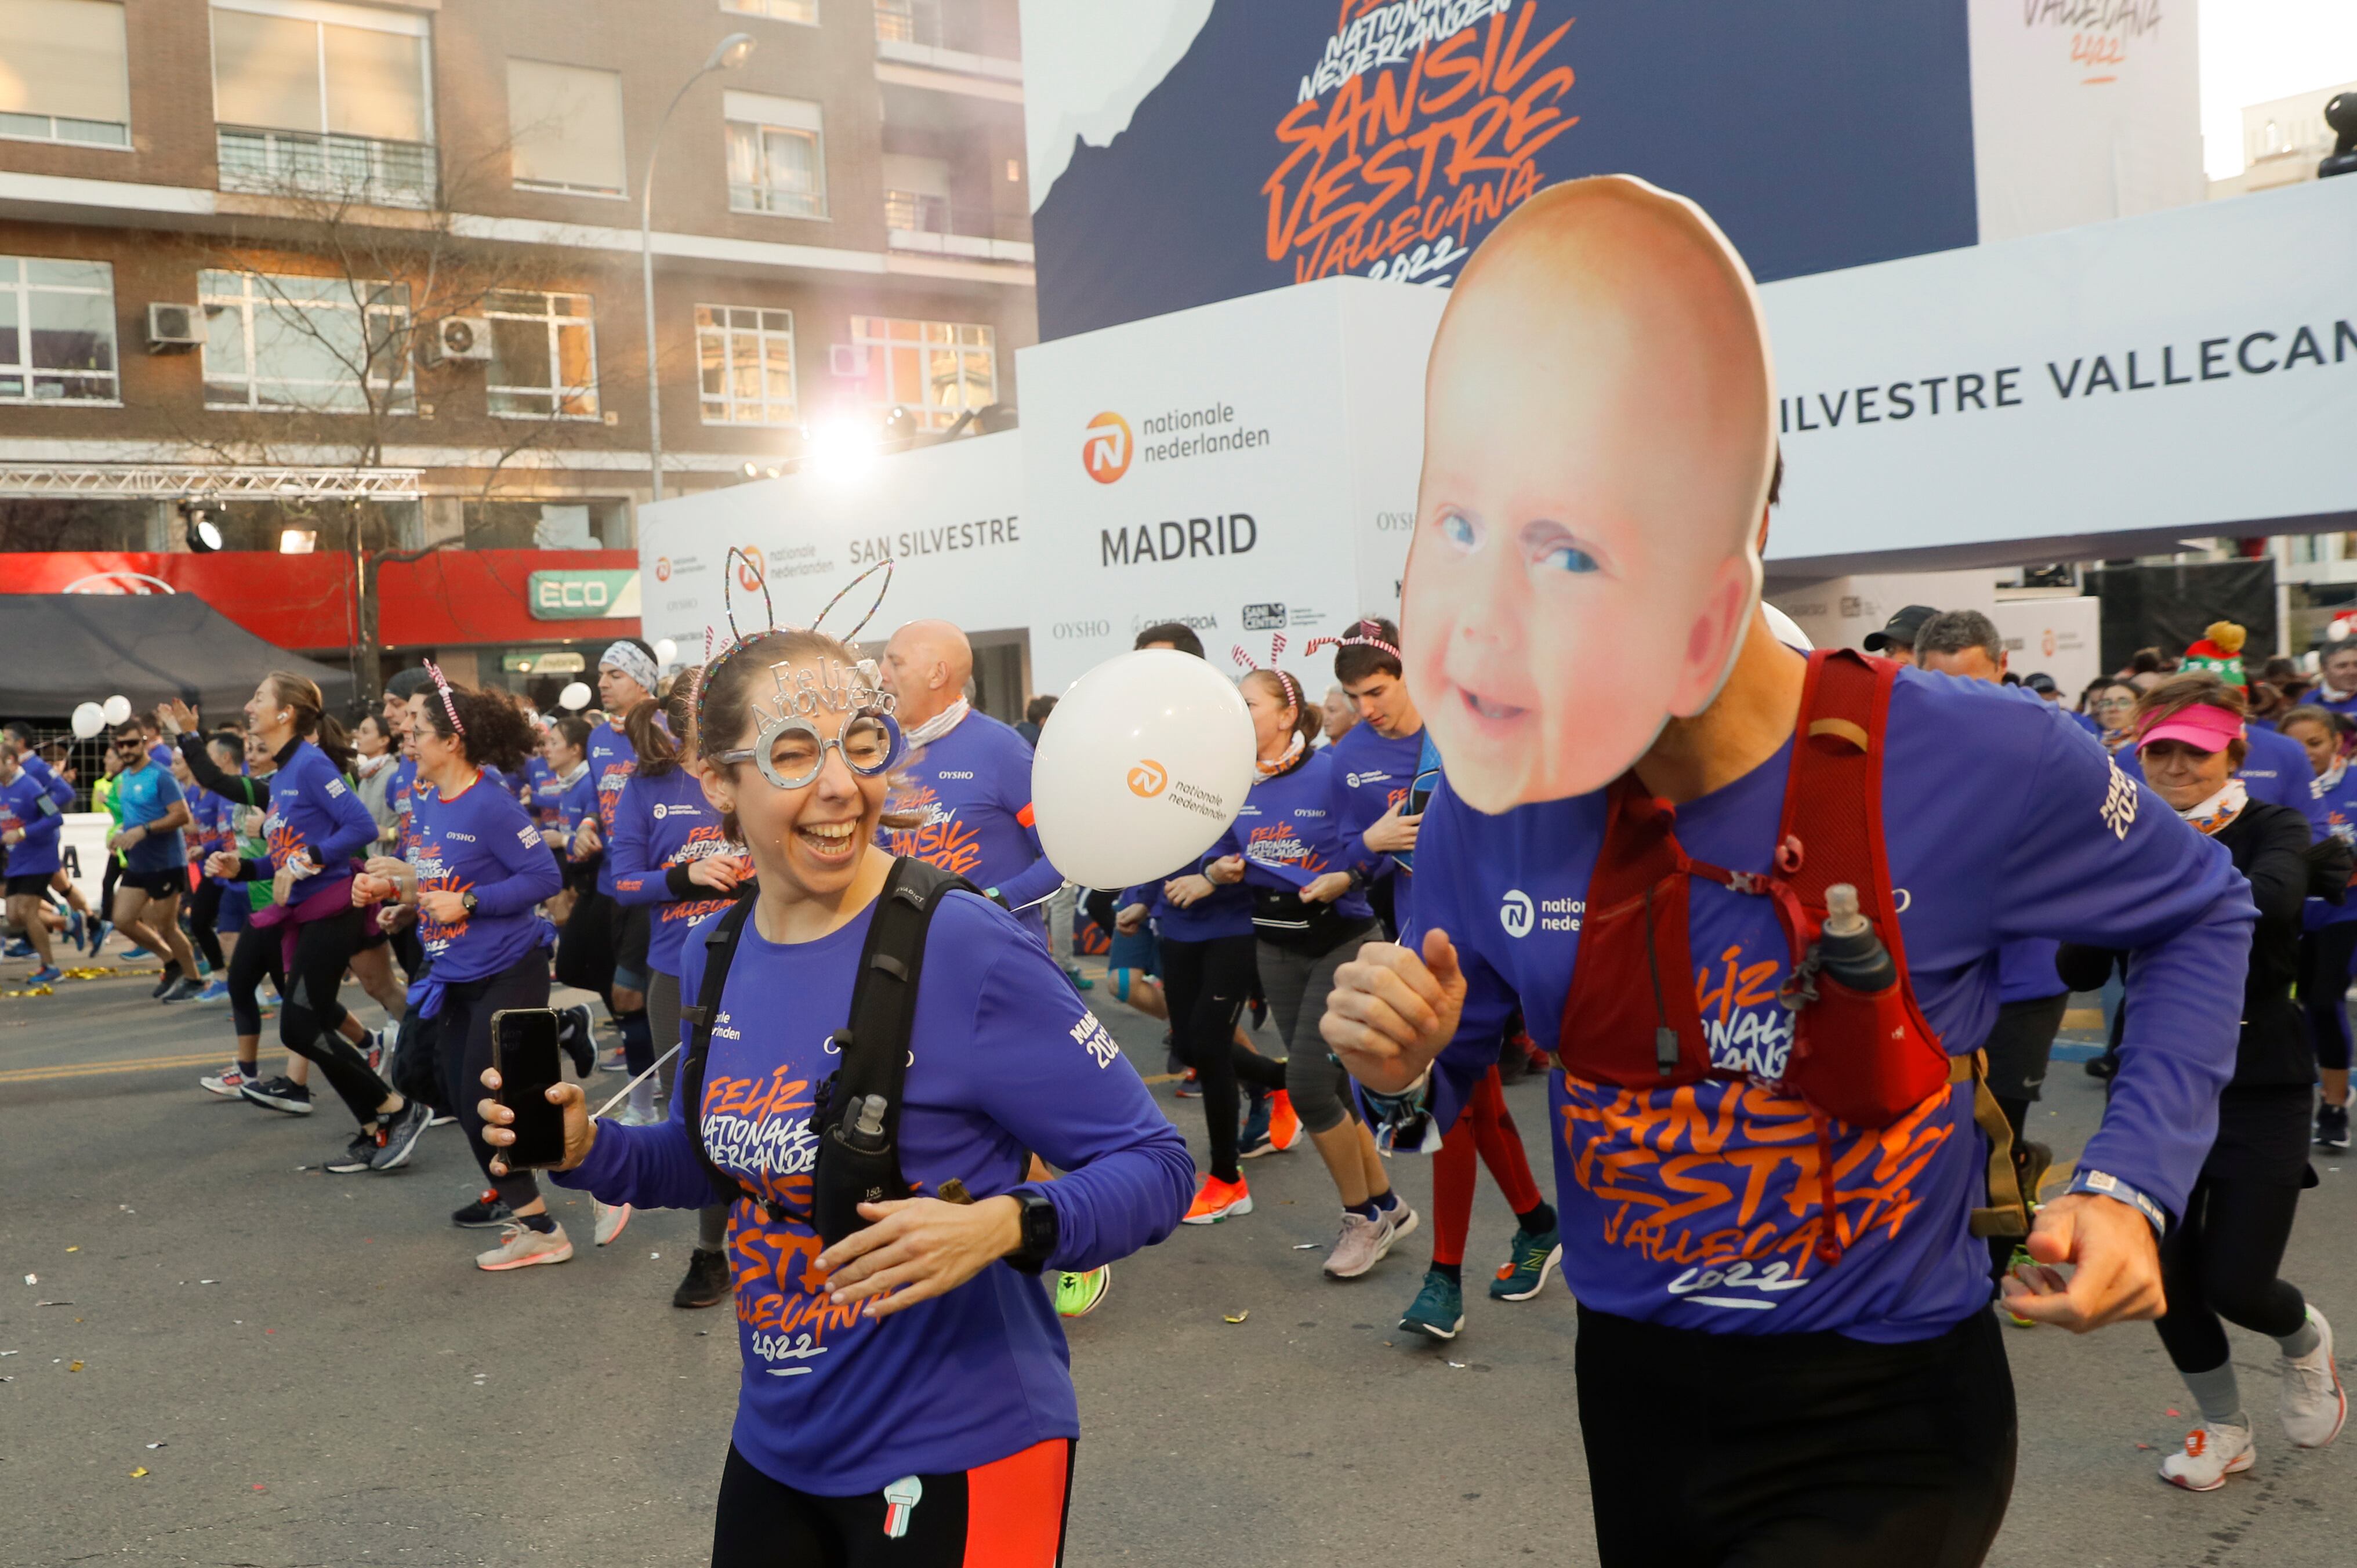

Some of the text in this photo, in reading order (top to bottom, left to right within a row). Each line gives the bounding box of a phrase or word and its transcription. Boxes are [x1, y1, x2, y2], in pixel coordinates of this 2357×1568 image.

[1267, 66, 1580, 261] VESTRE
[1781, 366, 2022, 433] ILVESTRE
[1143, 402, 1235, 435] nationale
[1145, 427, 1270, 463] nederlanden
[850, 516, 1020, 564] SAN SILVESTRE
[1101, 513, 1257, 567] MADRID
[539, 580, 608, 608] ECO
[1053, 619, 1110, 639] OYSHO
[938, 771, 974, 780] OYSHO
[1168, 792, 1227, 822] nederlanden
[1176, 781, 1223, 807] nationale
[1294, 808, 1326, 818] OYSHO
[701, 1065, 817, 1125] FELIZ
[1668, 1261, 1810, 1294] 2022
[752, 1331, 828, 1362] 2022
